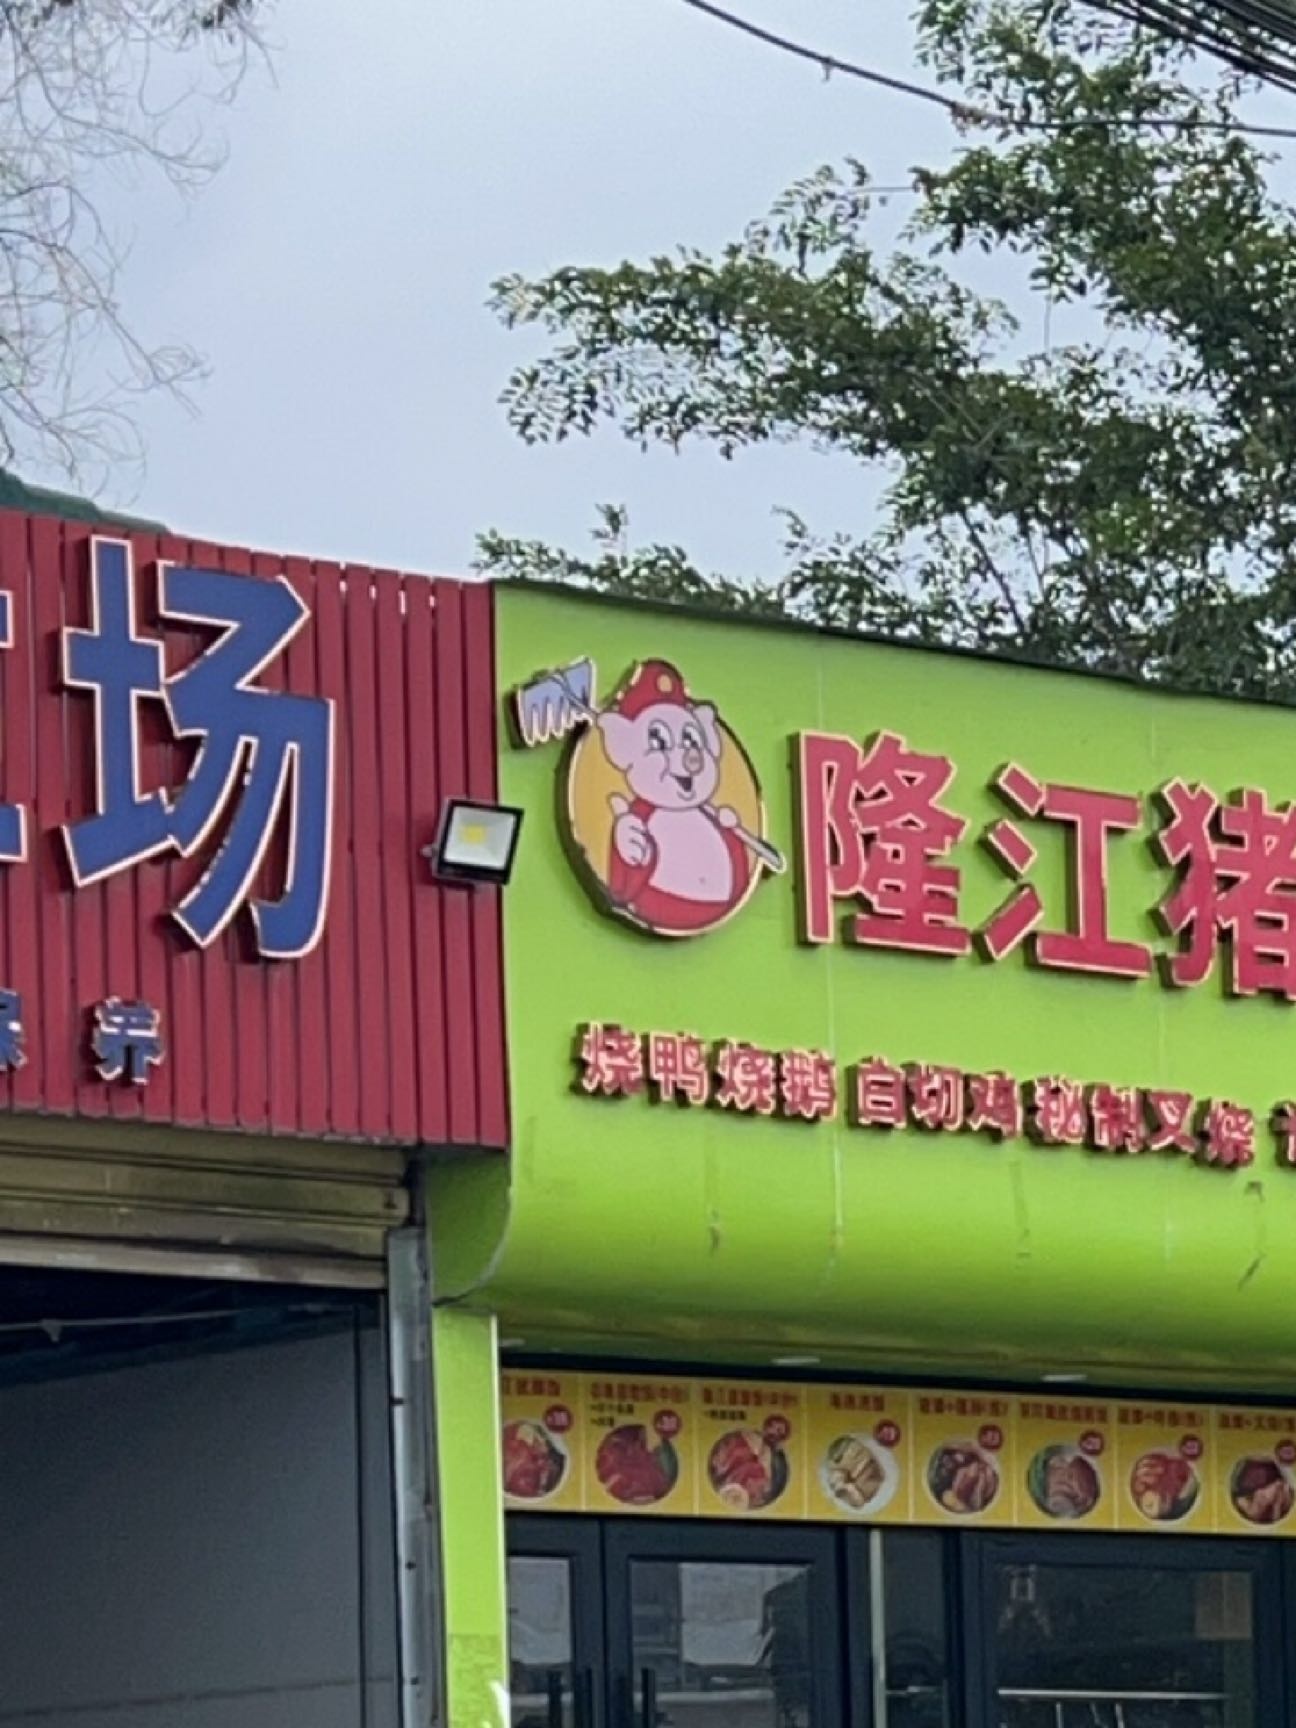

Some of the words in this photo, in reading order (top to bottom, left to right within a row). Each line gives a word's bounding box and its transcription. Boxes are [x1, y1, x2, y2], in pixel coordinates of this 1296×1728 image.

[0, 534, 336, 958] 场
[578, 1021, 837, 1121] 烧鸭烧鹅
